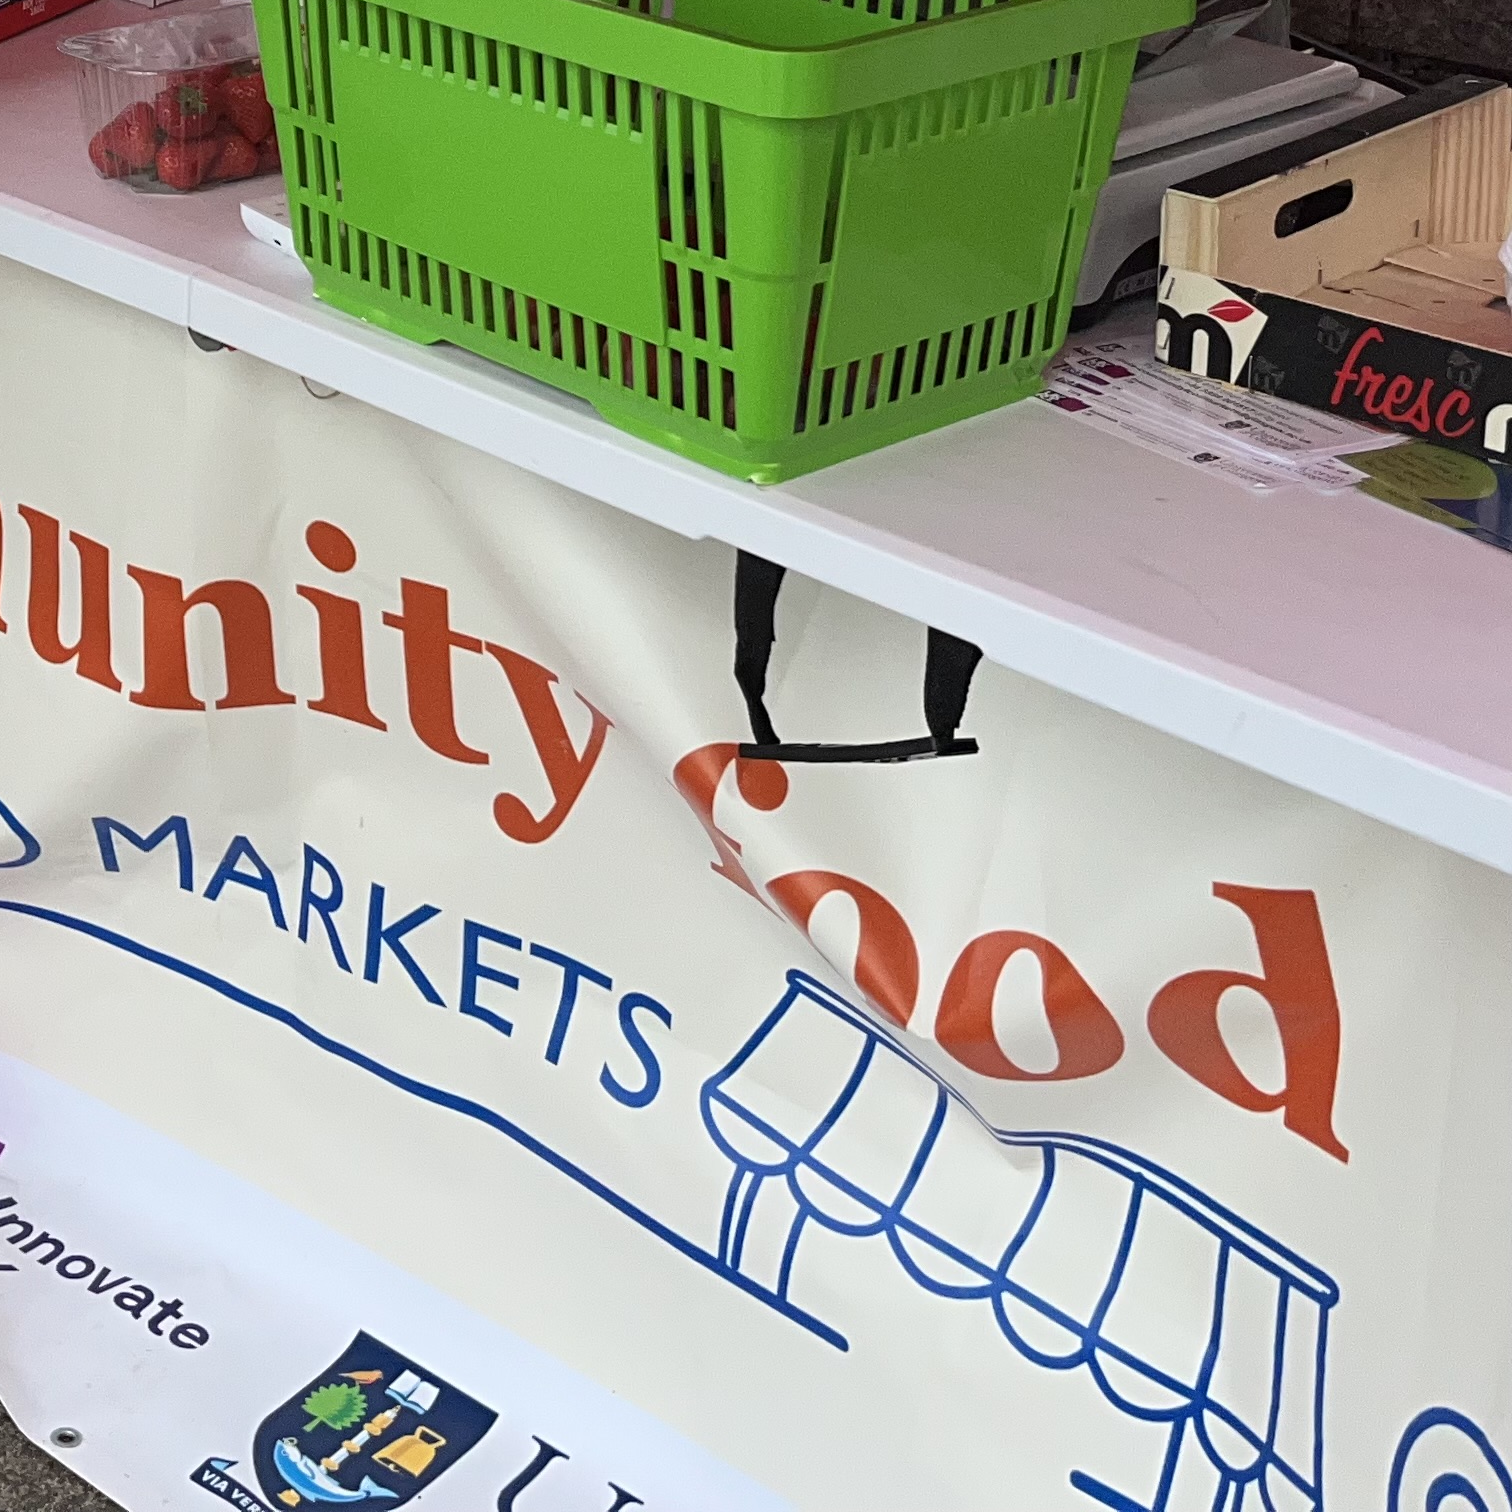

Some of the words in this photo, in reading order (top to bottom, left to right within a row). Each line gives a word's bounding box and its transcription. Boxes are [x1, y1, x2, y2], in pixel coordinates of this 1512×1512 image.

[90, 814, 673, 1109] MARKETS
[201, 1469, 229, 1493] VIA
[231, 1488, 265, 1512] VER
